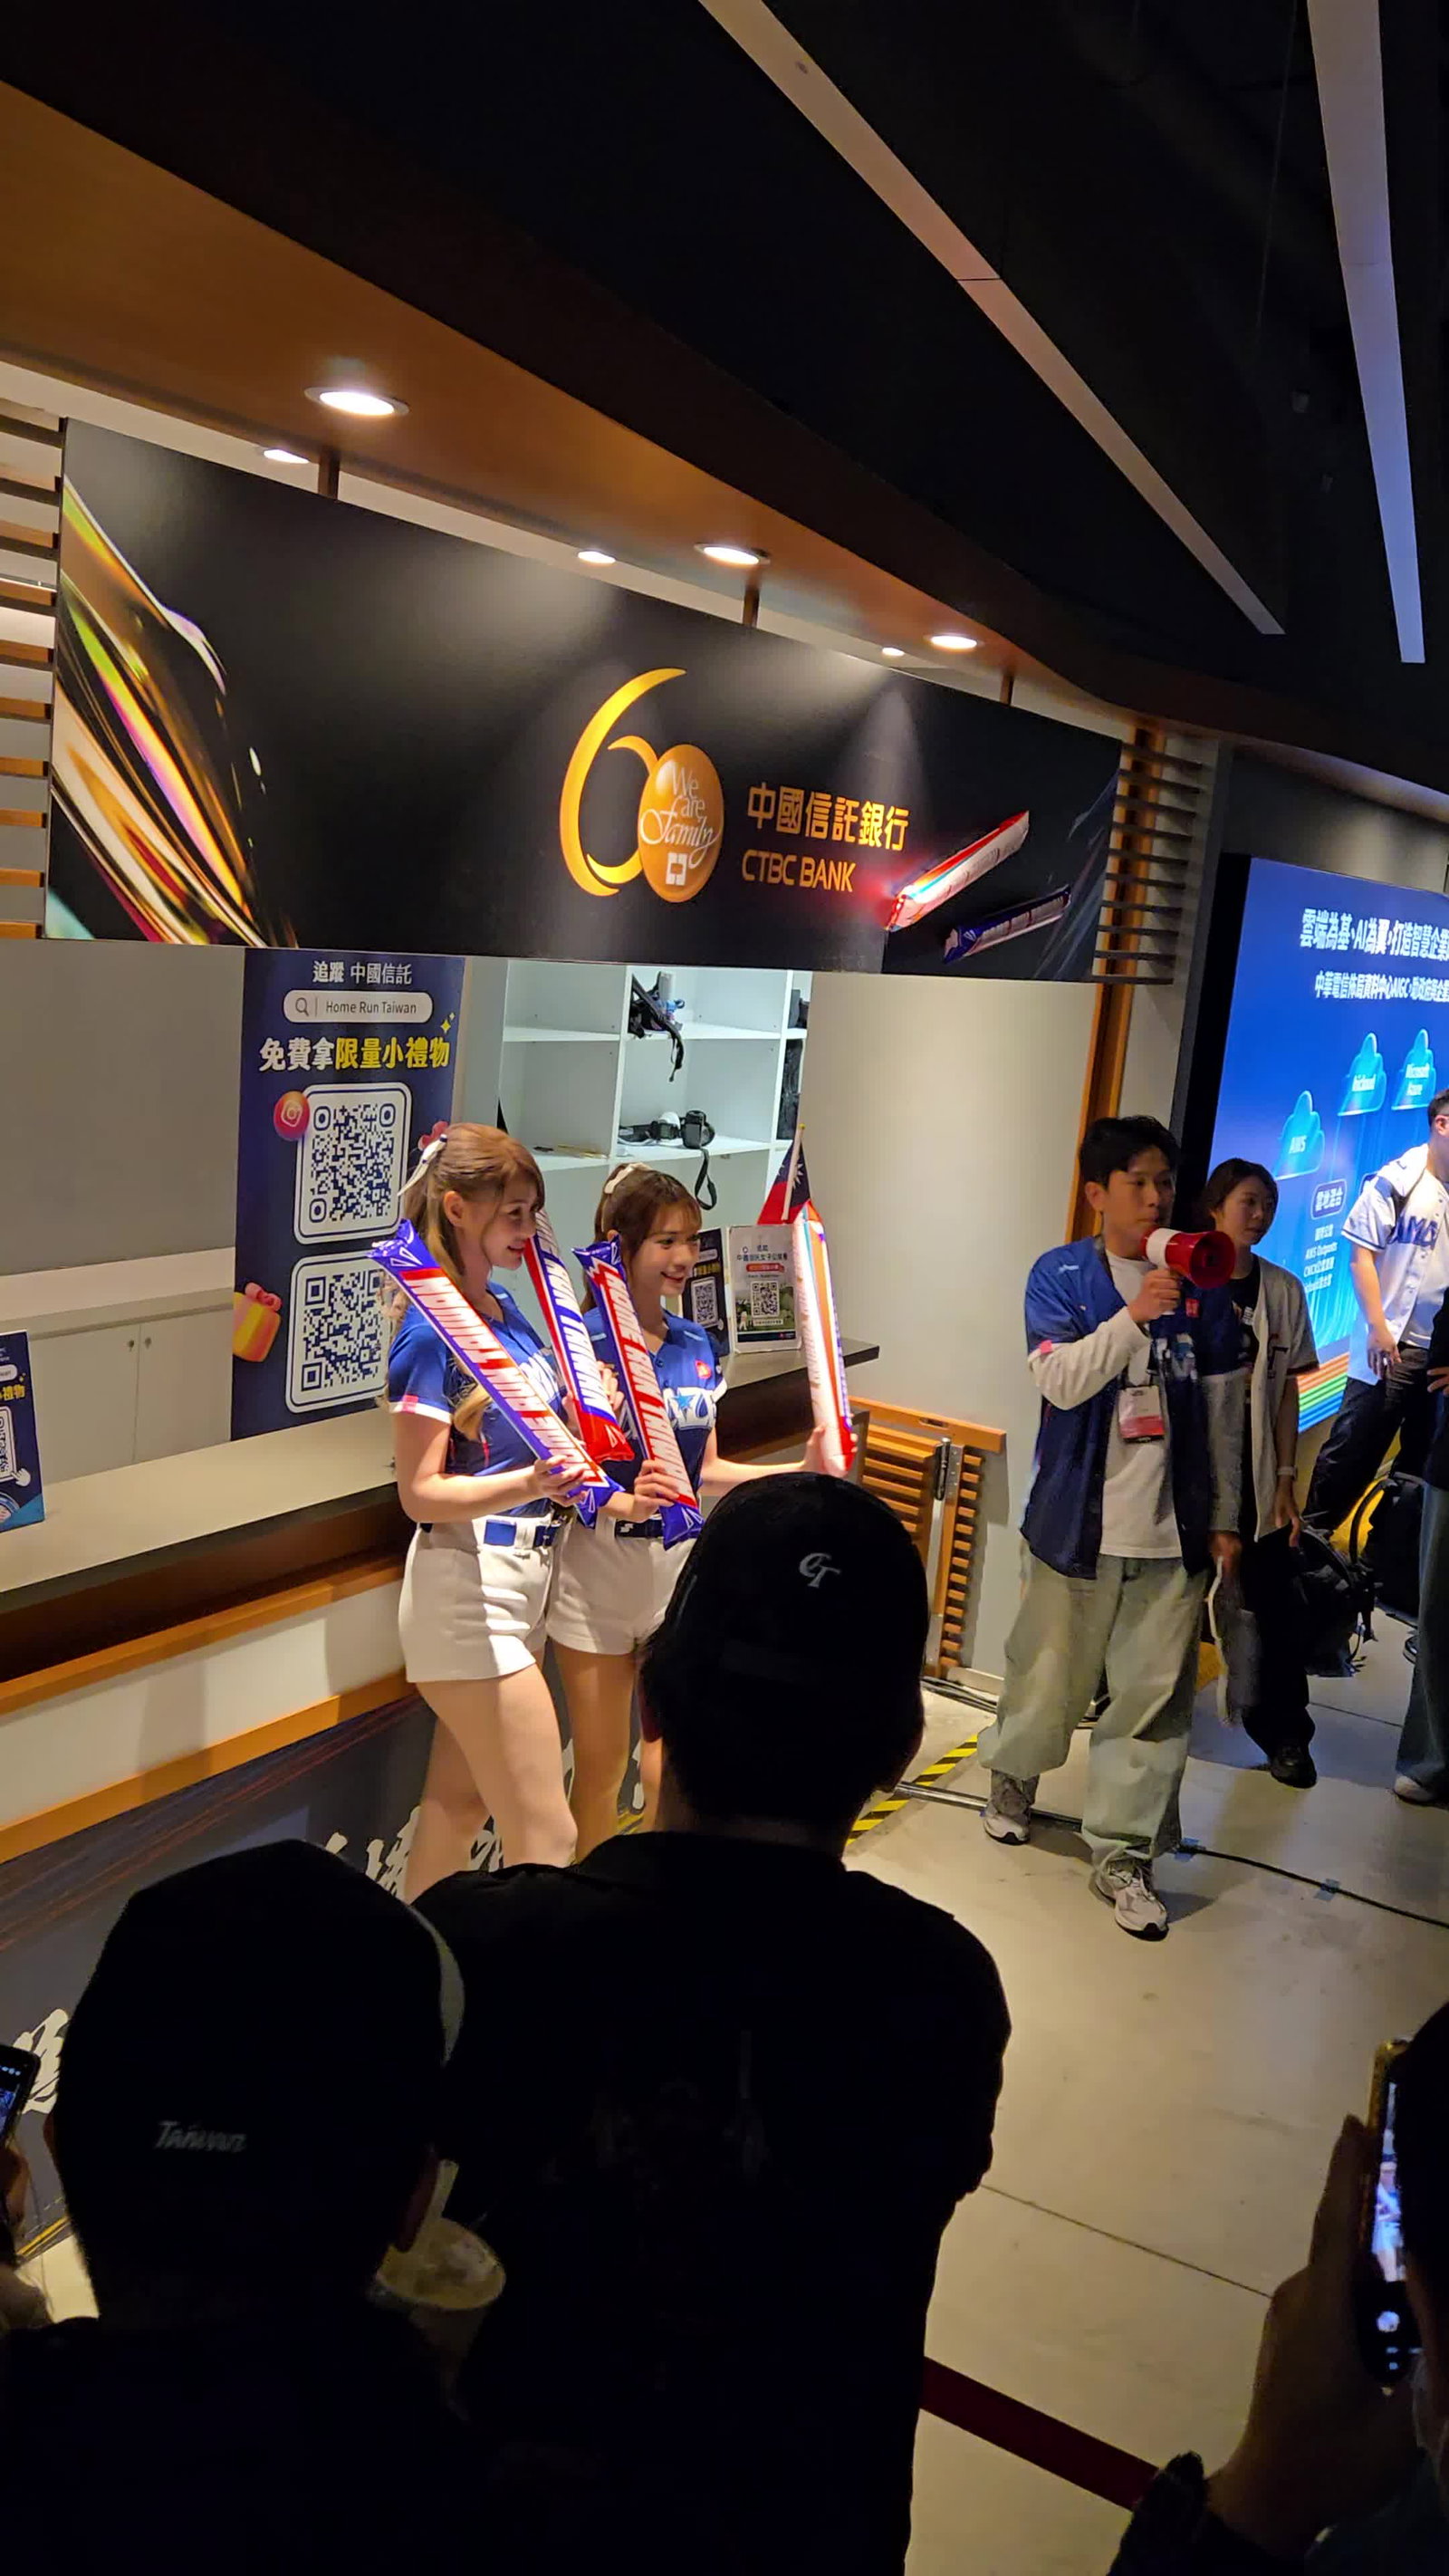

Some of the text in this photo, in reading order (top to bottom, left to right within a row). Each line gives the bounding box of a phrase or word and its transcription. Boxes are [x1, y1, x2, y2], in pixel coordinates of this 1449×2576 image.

[671, 766, 699, 798] We
[639, 795, 721, 870] Family
[747, 782, 909, 851] 中國信託銀行
[742, 849, 857, 893] CTBC BANK
[312, 960, 413, 985] 追蹤 中國信託
[325, 1000, 417, 1014] Home Run Taiwan
[258, 1036, 451, 1072] 免費拿限量小禮物
[403, 1276, 513, 1364] TAIWAN
[601, 1271, 646, 1344] HOME
[624, 1343, 664, 1404] RUN
[479, 1366, 550, 1412] RUN
[153, 2119, 247, 2154] Taiwan
